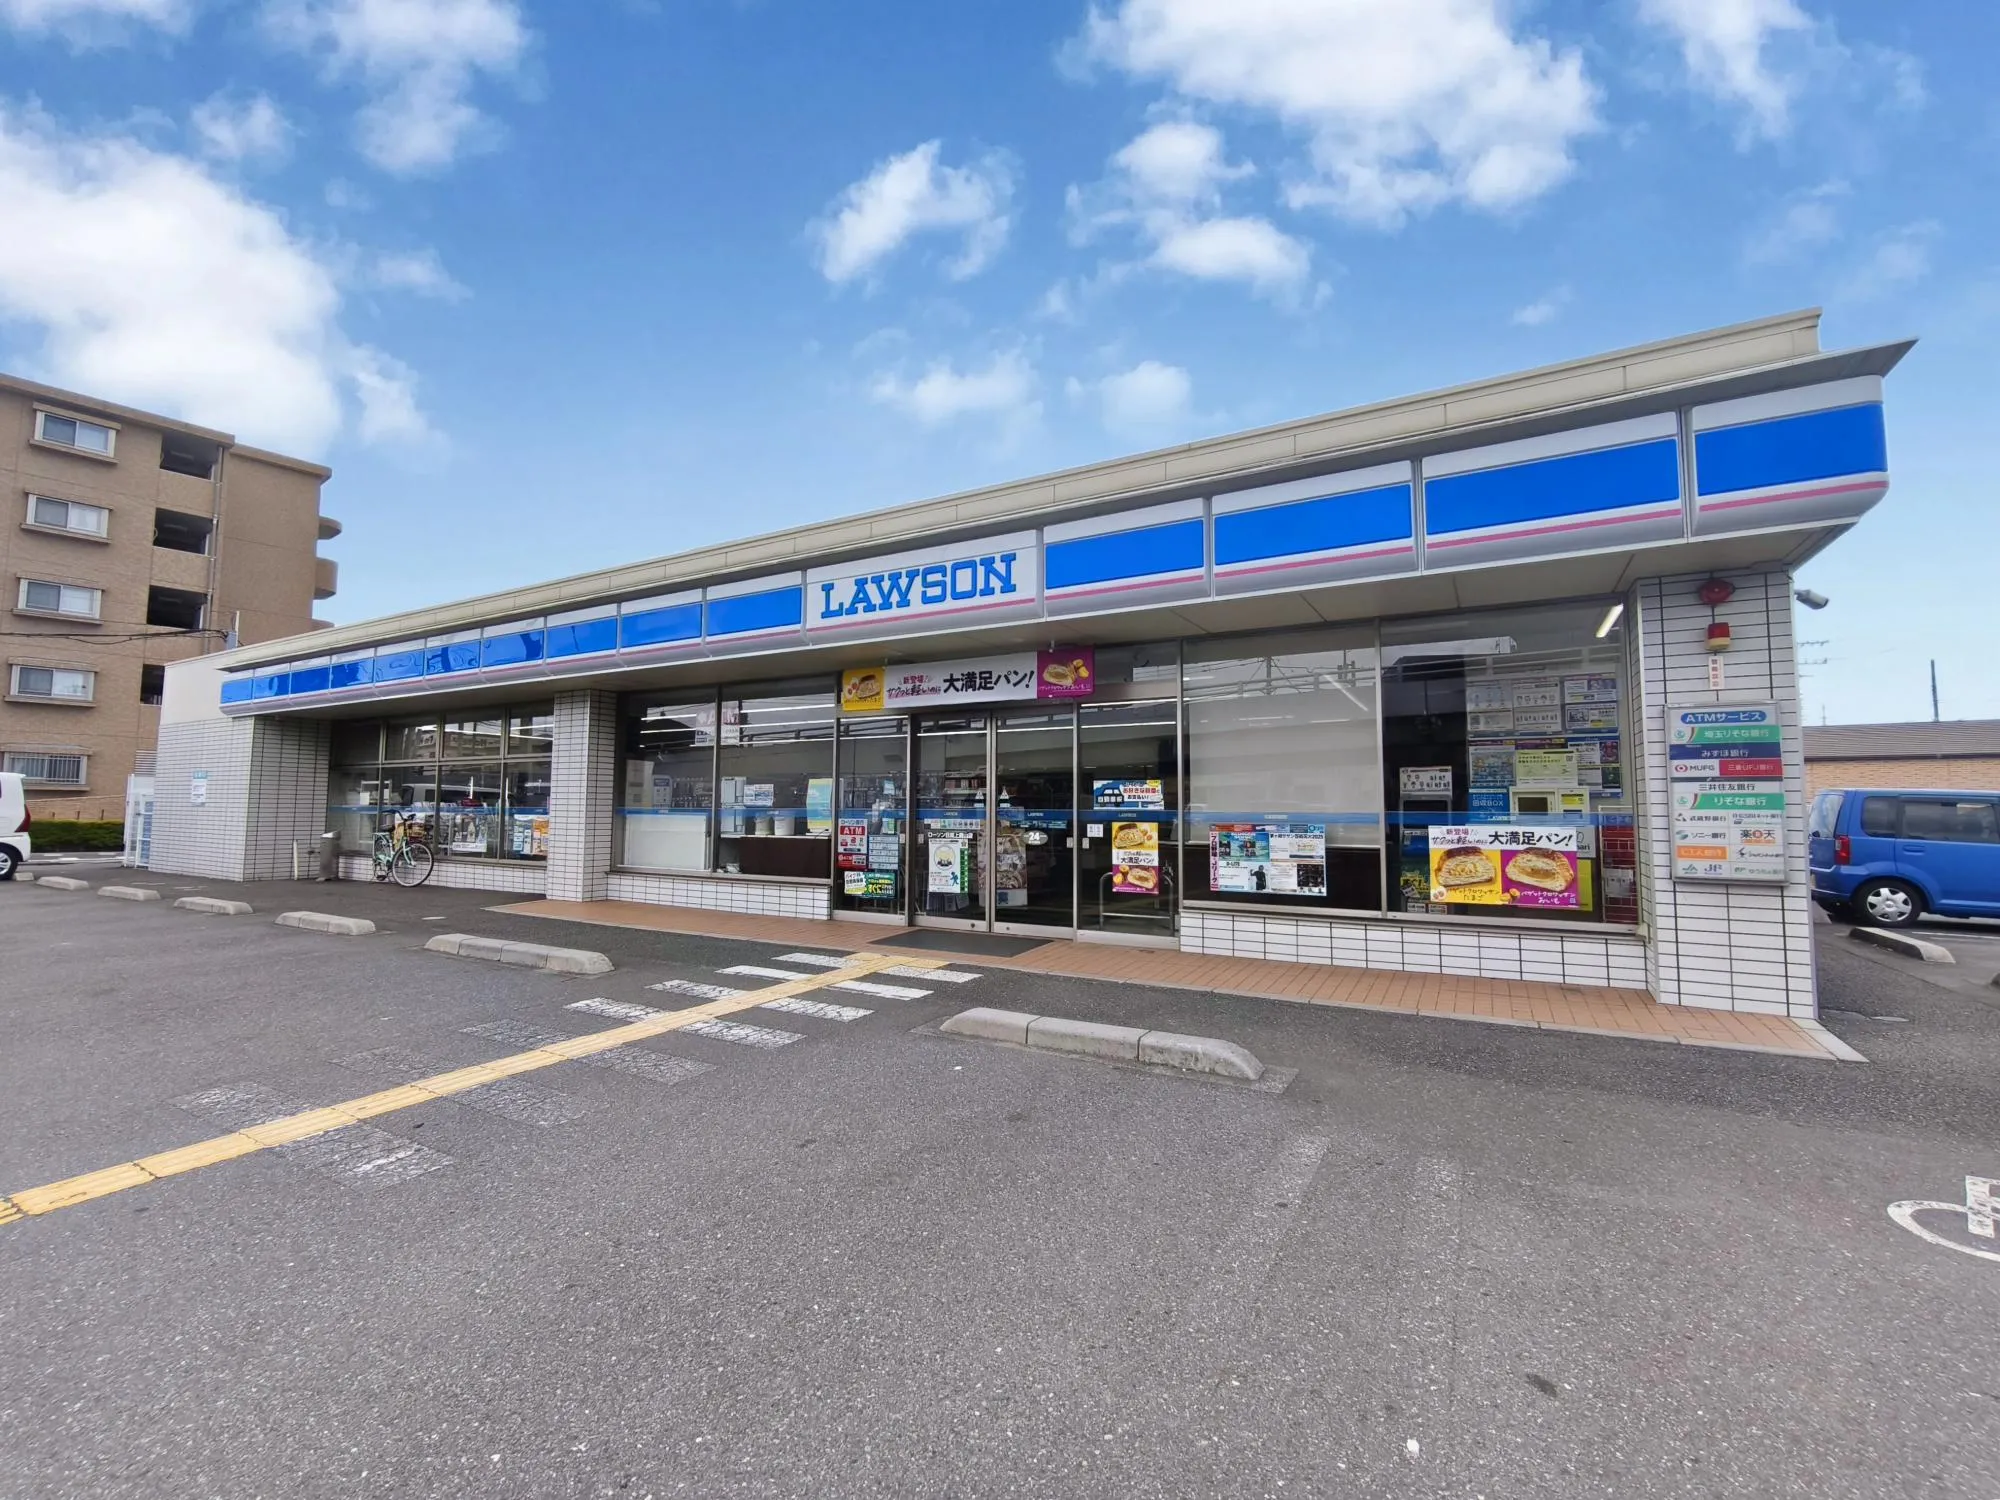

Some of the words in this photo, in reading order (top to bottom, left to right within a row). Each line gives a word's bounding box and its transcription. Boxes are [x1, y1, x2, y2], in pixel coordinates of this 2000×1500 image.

[821, 553, 1016, 619] LAWSON
[943, 670, 1035, 694] 大満足パン!
[1686, 711, 1761, 723] ATMサービス
[1704, 729, 1769, 739] 埼玉りそな銀行
[1701, 749, 1749, 758] みずほ銀行
[1689, 764, 1715, 772] MUFG
[1698, 783, 1755, 791] 三井住友銀行
[1714, 796, 1767, 806] りそな銀行
[843, 826, 862, 835] ATM
[1028, 832, 1040, 841] 24
[1489, 831, 1573, 847] 大満足パン!
